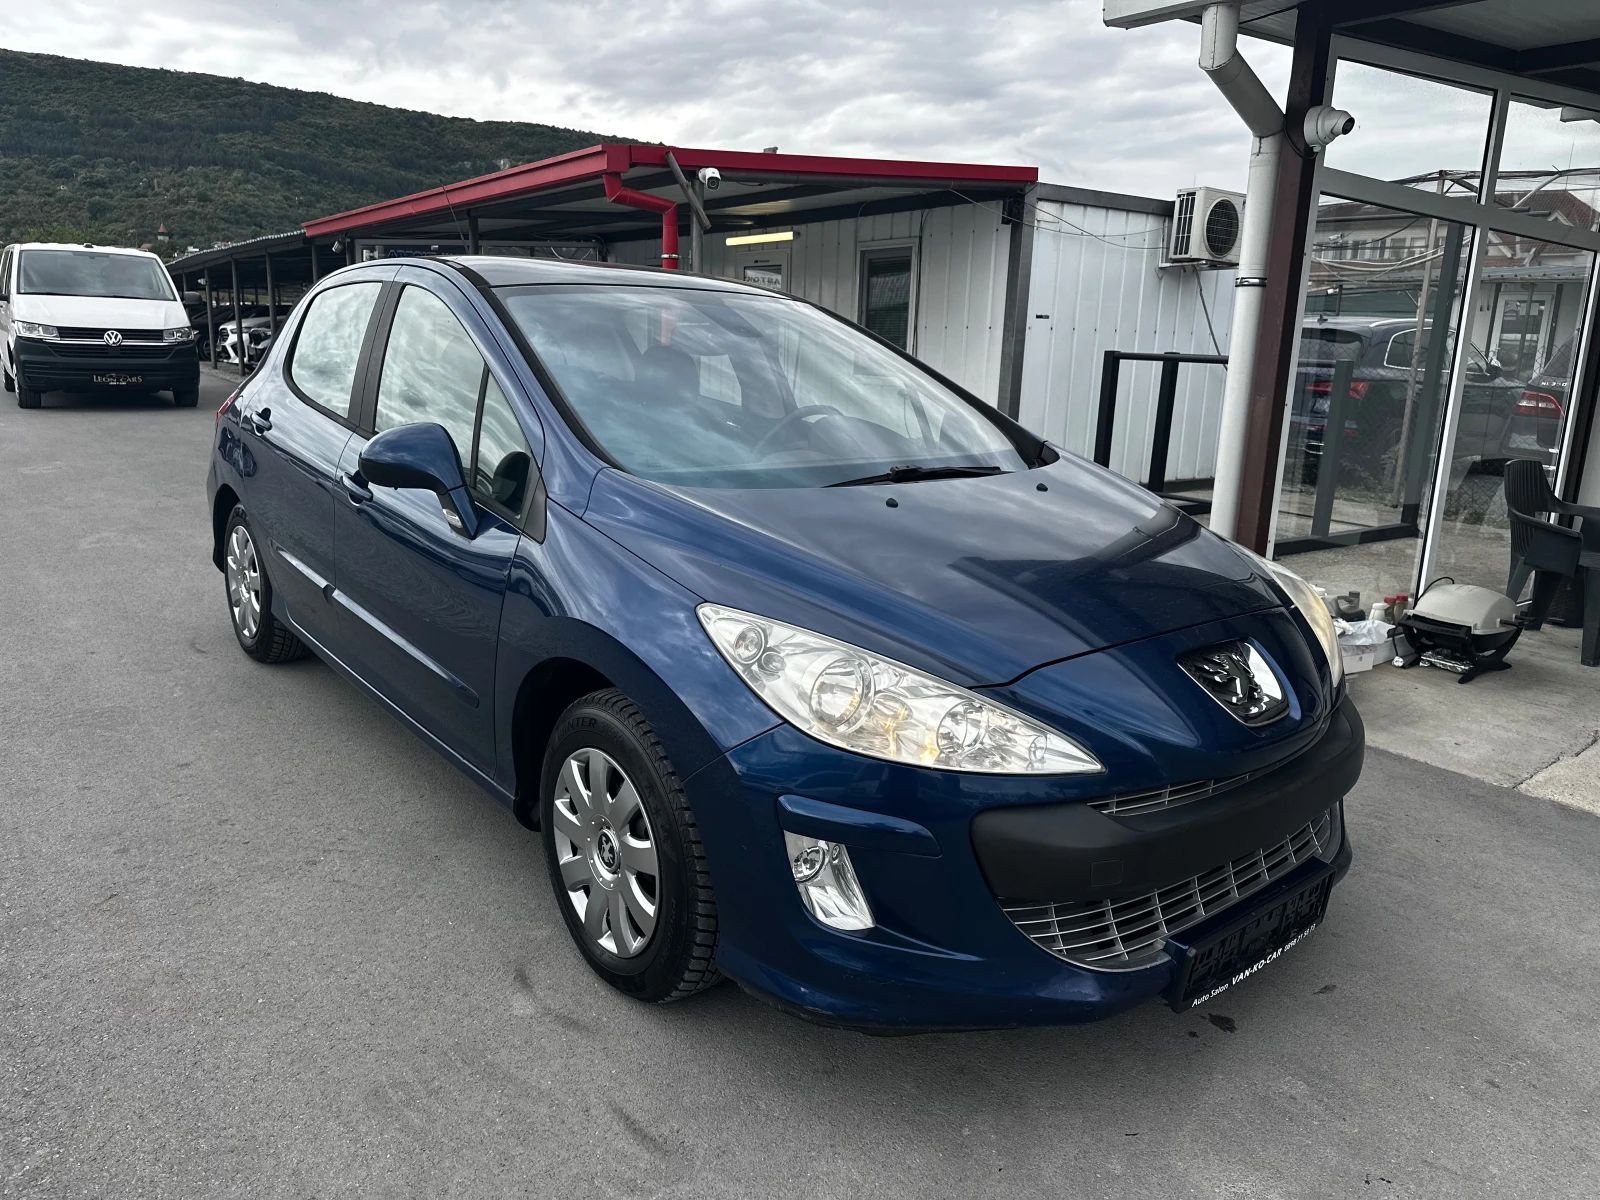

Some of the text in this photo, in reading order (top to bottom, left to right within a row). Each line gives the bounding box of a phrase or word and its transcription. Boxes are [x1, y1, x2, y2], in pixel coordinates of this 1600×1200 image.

[1191, 994, 1210, 1008] Auto
[1210, 983, 1229, 998] Salon
[1231, 947, 1283, 986] VAN-KO-CAR
